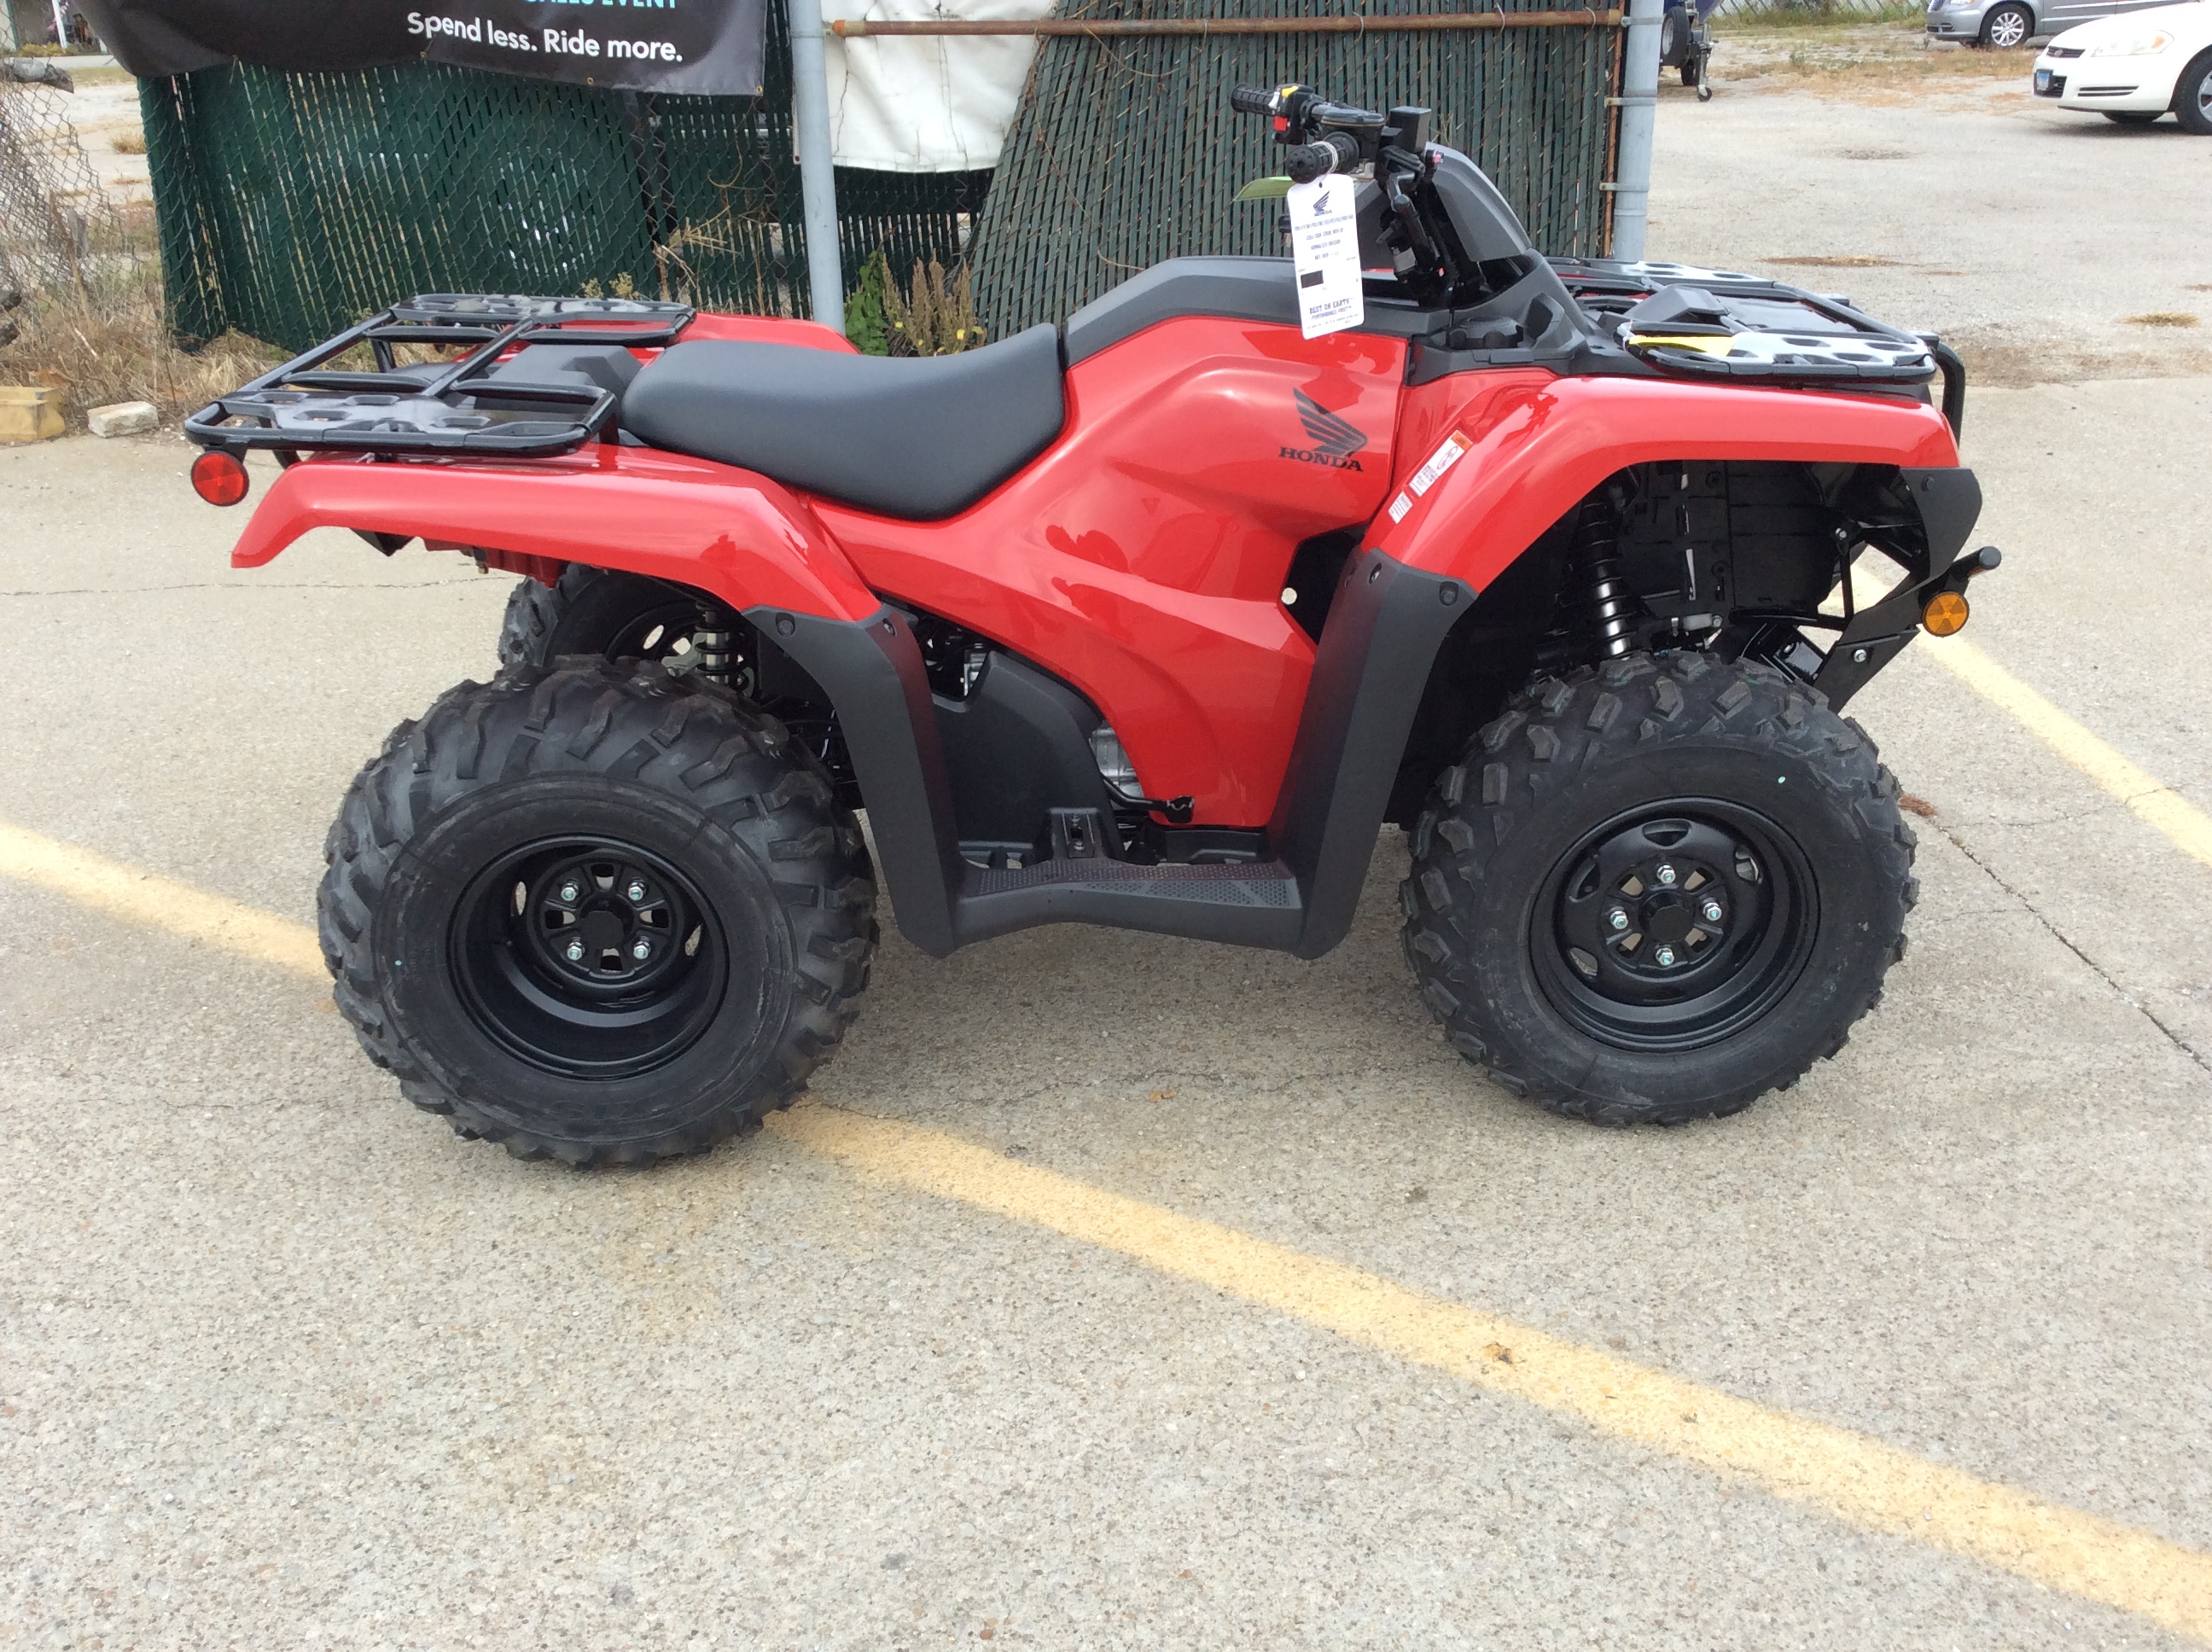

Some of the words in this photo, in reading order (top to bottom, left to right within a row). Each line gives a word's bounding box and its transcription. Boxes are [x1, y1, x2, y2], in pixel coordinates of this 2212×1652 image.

[407, 12, 482, 42] Spend
[487, 20, 538, 52] less.
[544, 29, 601, 56] Ride
[608, 40, 683, 62] more.
[1278, 446, 1364, 472] HONDA
